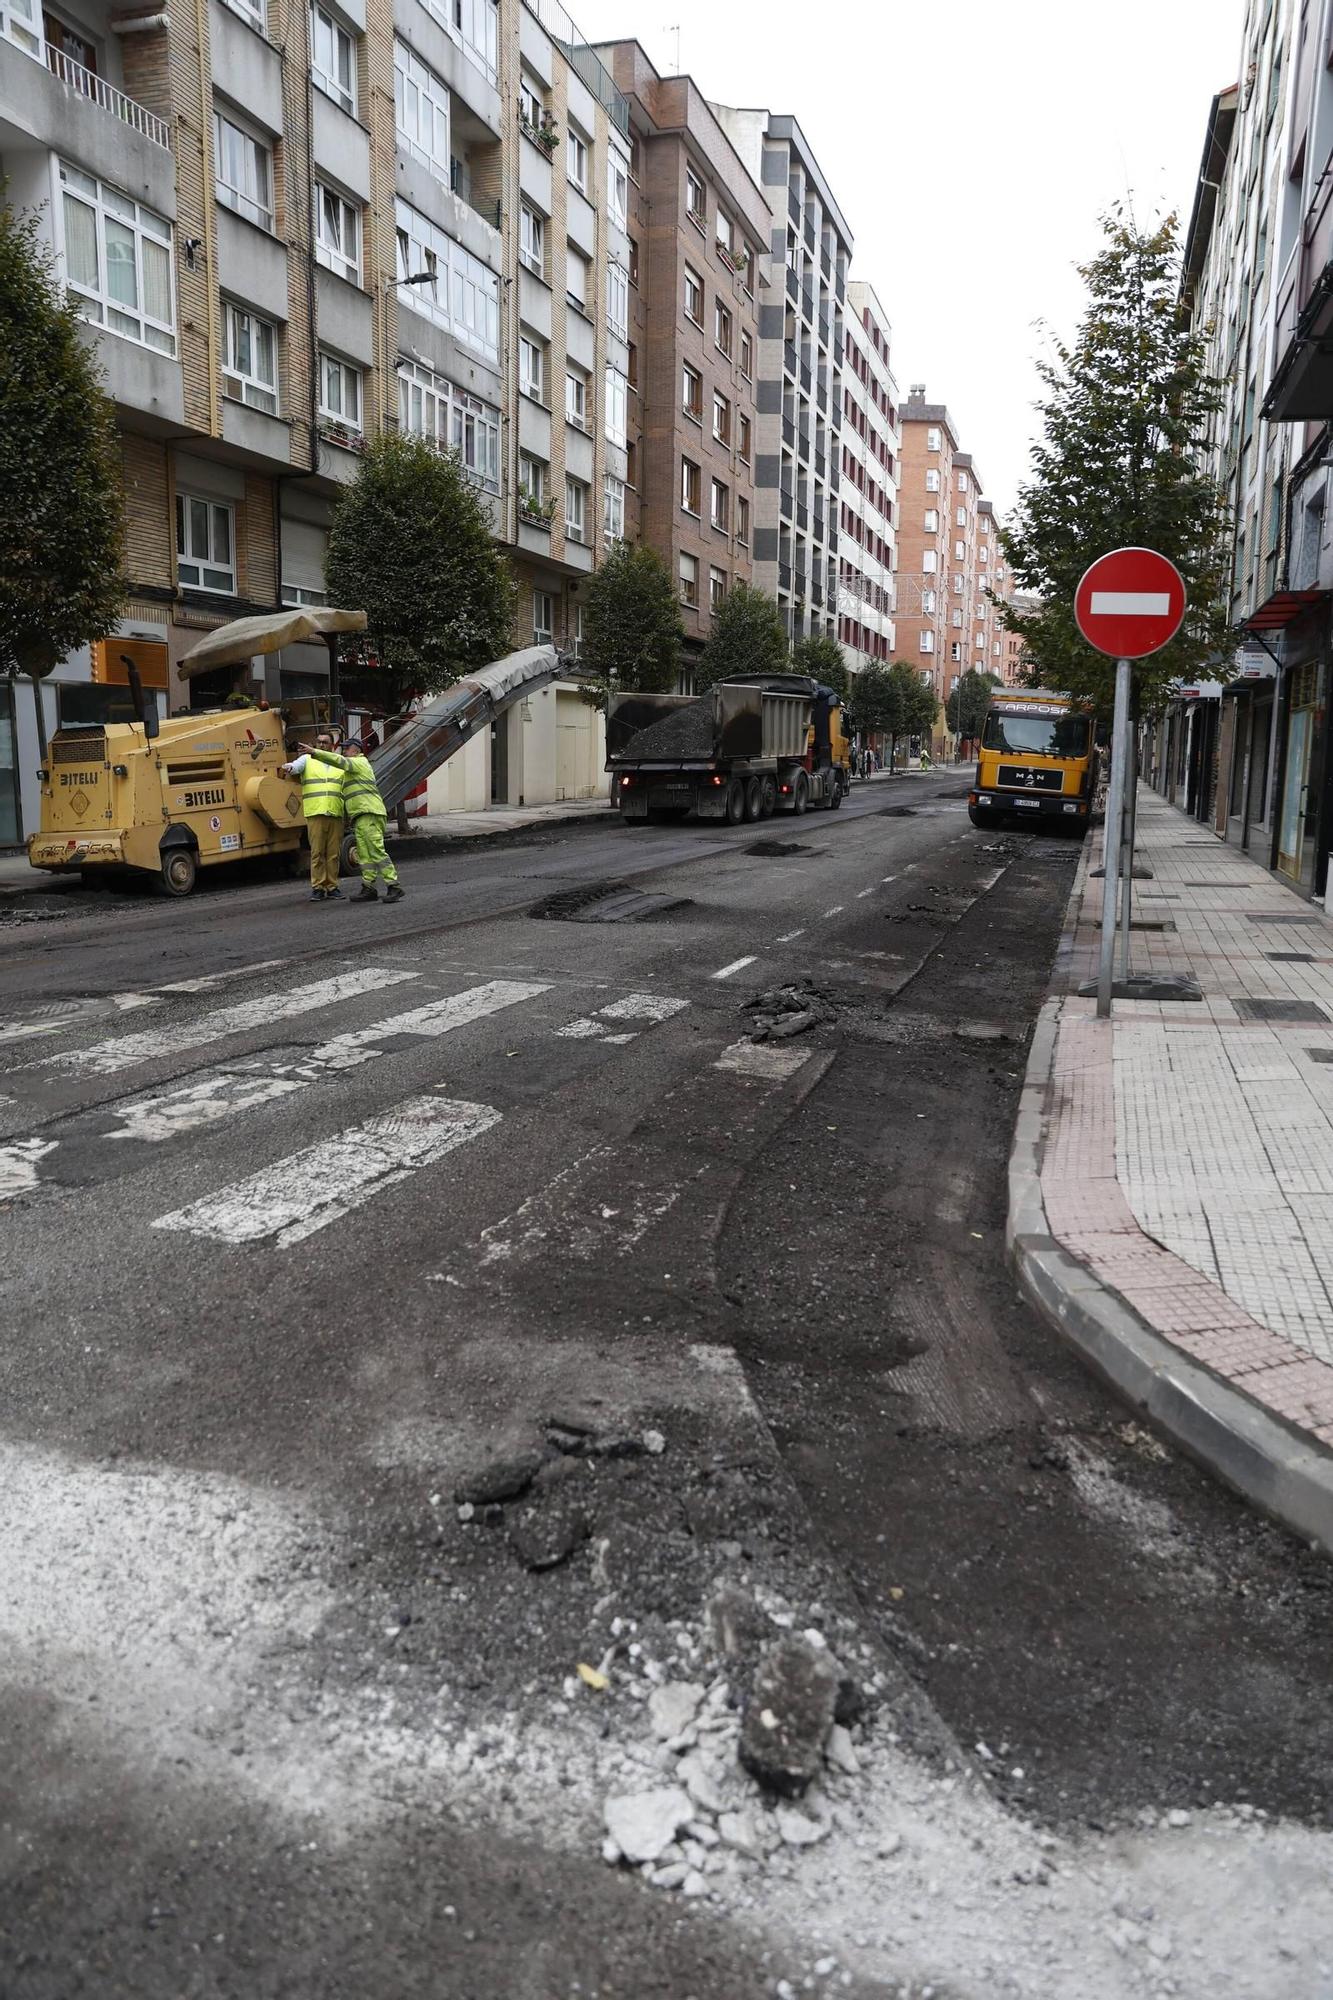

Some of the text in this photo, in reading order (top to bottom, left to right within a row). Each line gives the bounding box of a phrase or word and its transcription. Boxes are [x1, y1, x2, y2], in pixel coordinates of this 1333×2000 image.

[234, 738, 279, 750] ARPOSA
[60, 771, 98, 786] BITELLI
[1015, 773, 1045, 781] MAN
[184, 788, 225, 807] BITELLI
